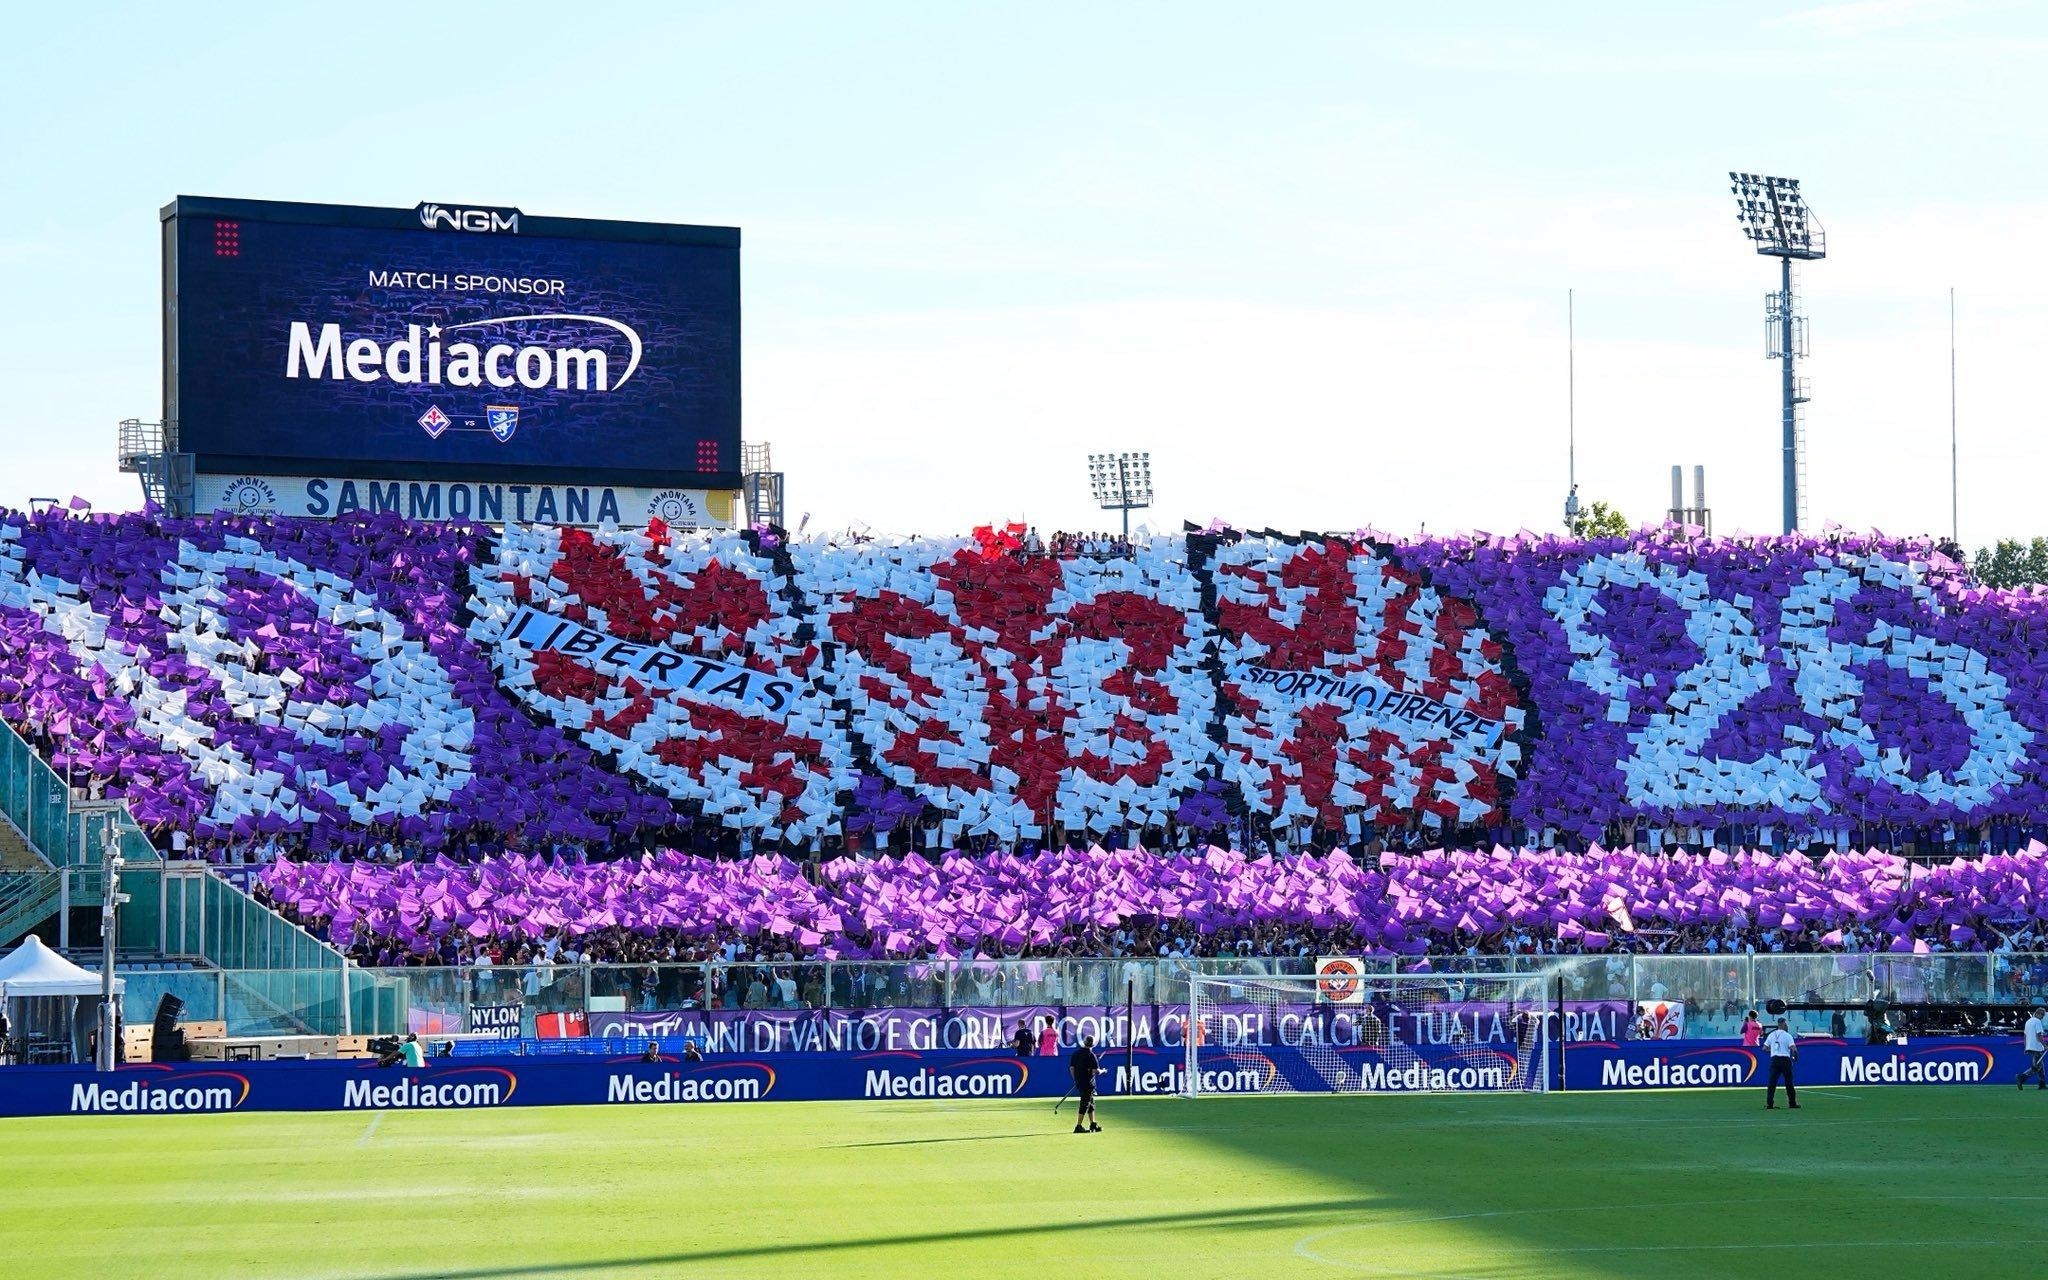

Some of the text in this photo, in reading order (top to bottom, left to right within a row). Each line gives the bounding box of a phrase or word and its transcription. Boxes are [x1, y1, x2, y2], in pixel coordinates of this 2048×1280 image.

[420, 204, 518, 233] NGM
[369, 271, 565, 296] MATCH SPONSOR
[286, 321, 608, 391] Mediacom
[223, 477, 276, 503] SAMMONTANA
[306, 478, 620, 524] SAMMONTANA
[647, 490, 696, 516] SAMMONTANA
[507, 611, 795, 712] LIBERTAS
[1241, 667, 1496, 739] SPORTIVO FIRENZE
[472, 1007, 520, 1026] NYLON
[754, 1020, 781, 1053] DI
[788, 1019, 881, 1052] VANTO
[888, 1018, 902, 1051] E
[910, 1016, 1003, 1051] GLORIA
[1033, 1015, 1154, 1048] RCORDA
[1222, 1013, 1272, 1047] DEL
[1279, 1013, 1372, 1047] CALCI
[1389, 1003, 1404, 1045] È
[1410, 1011, 1466, 1046] TUA
[1473, 1011, 1506, 1044] LA
[1513, 1010, 1616, 1043] TORIA!
[865, 1067, 1012, 1097] Mediacom
[1115, 1064, 1260, 1092] Medicom
[1361, 1062, 1503, 1090] Mediacom
[1602, 1057, 1742, 1086] Mediacom
[1840, 1054, 1979, 1083] Mediacom
[71, 1081, 232, 1112] Mediacom
[343, 1075, 500, 1109] Mediacom
[608, 1072, 758, 1101] Mediacom
